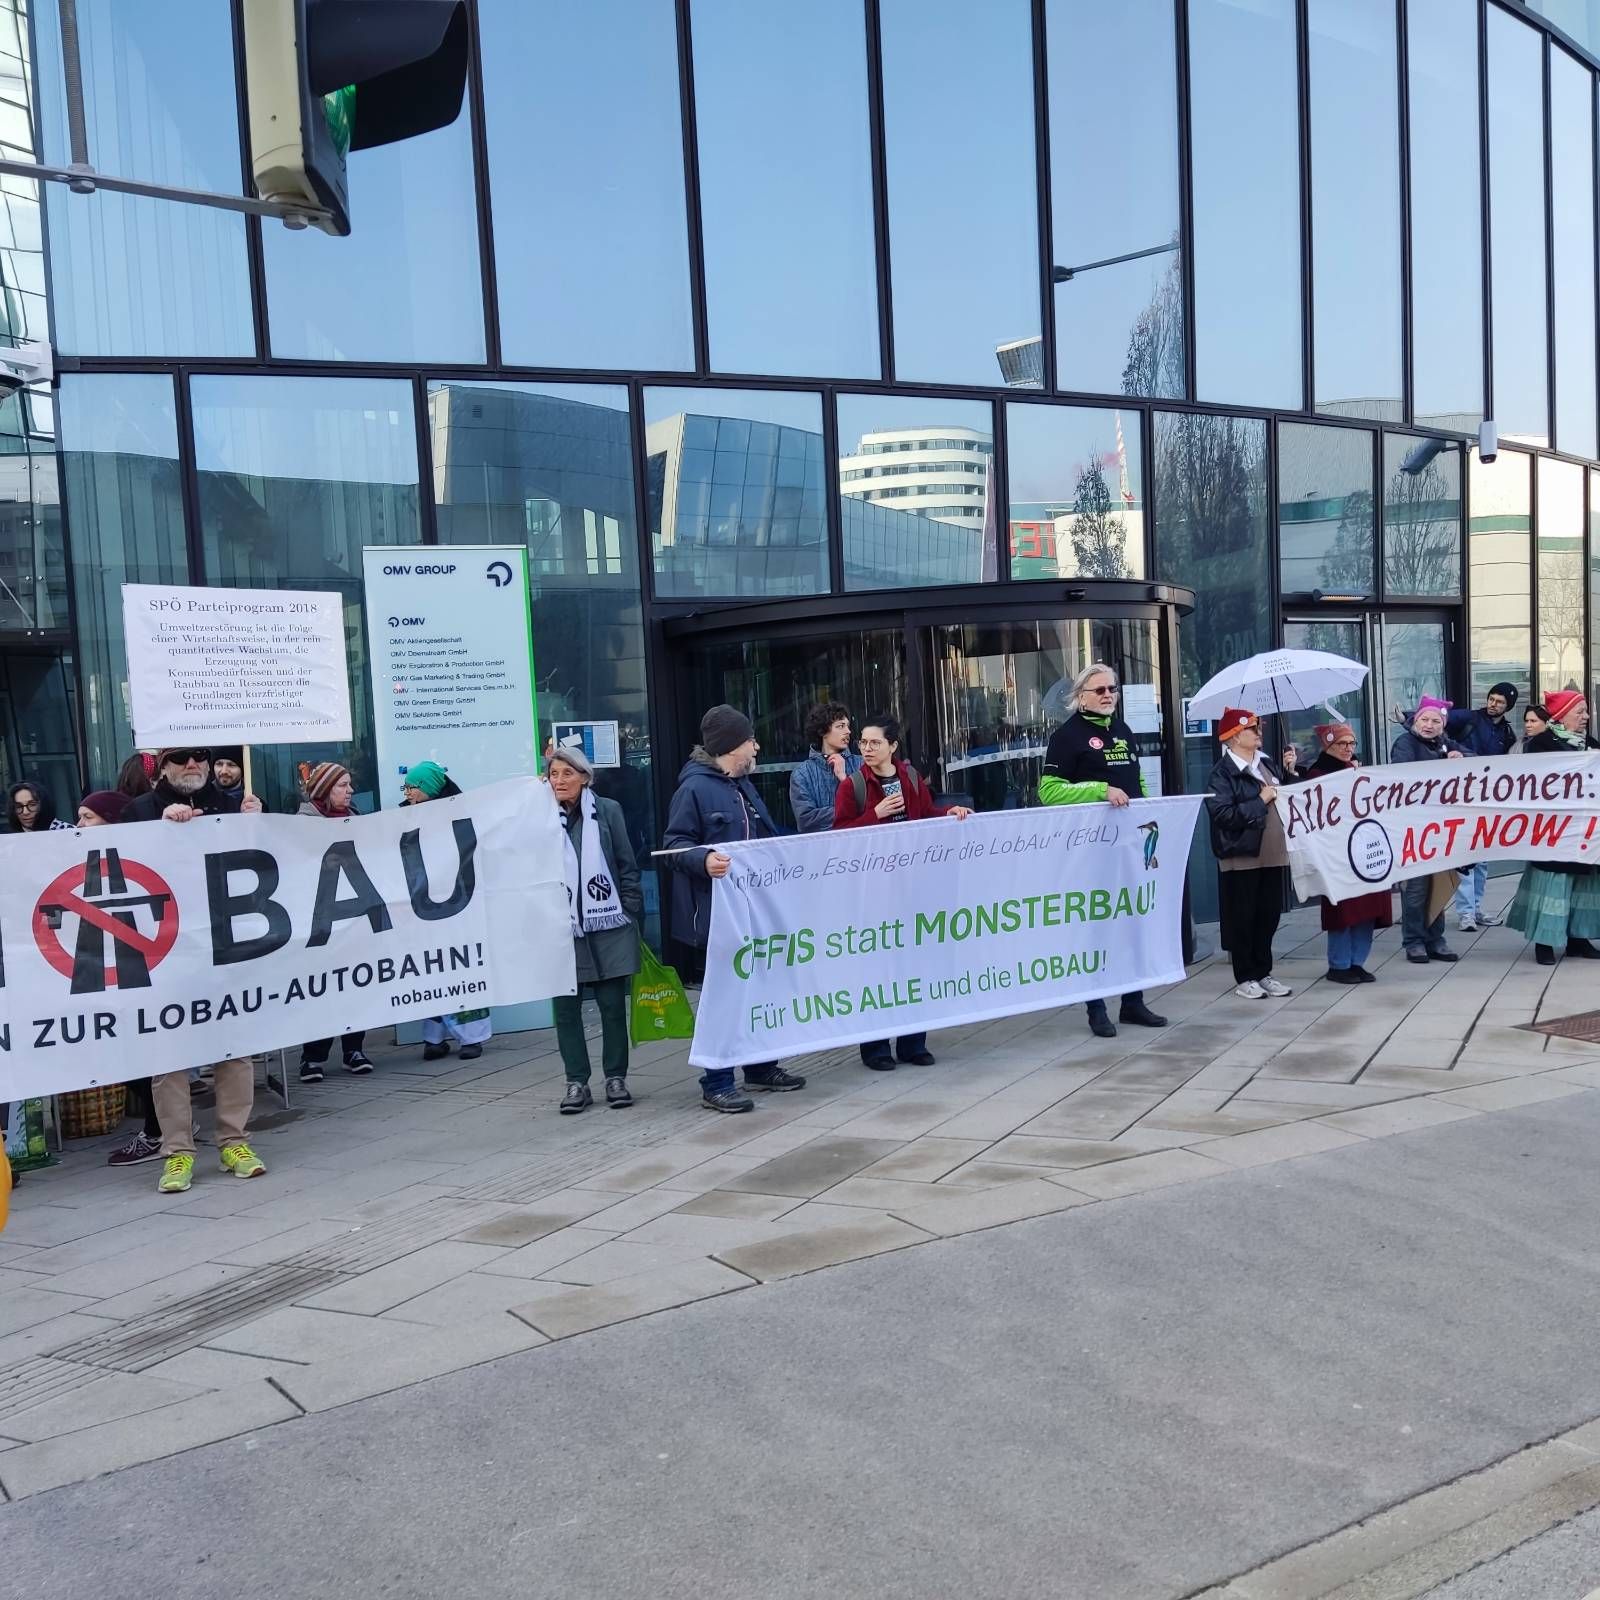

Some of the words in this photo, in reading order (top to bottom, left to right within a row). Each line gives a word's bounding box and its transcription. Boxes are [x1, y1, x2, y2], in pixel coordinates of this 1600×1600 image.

[383, 566, 411, 576] OMV
[415, 564, 456, 575] GROUP
[149, 597, 182, 612] SPÖ
[187, 600, 284, 614] Parteiprogram
[289, 602, 318, 613] 2018
[402, 617, 425, 626] OMV
[159, 622, 252, 634] Umweltzerstörung
[256, 624, 268, 632] ist
[270, 624, 286, 632] die
[289, 623, 314, 634] Folge
[151, 635, 178, 644] einer
[272, 635, 282, 643] in
[284, 634, 300, 643] der
[303, 635, 321, 644] rein
[168, 646, 235, 656] quantitatives
[294, 646, 309, 654] die
[204, 657, 258, 668] Erzeugung
[276, 668, 294, 676] und
[297, 668, 312, 676] der
[174, 679, 220, 688] Raubbau
[224, 680, 236, 688] an
[239, 678, 293, 688] Ressourcen
[296, 678, 310, 687] die
[416, 686, 454, 694] International
[182, 690, 242, 702] Grundlagen
[246, 690, 304, 700] kurzfristiger
[184, 701, 279, 712] Profitmaximierung
[282, 700, 304, 709] sind.
[432, 698, 454, 706] Energy
[488, 720, 499, 728] der
[1105, 752, 1128, 760] KEINE
[1287, 782, 1342, 839] Alle
[1350, 765, 1596, 819] Generationen:
[923, 844, 958, 867] für
[958, 837, 985, 861] die
[1066, 824, 1120, 851] (EfdL)
[1401, 818, 1466, 867] ACT
[1470, 813, 1572, 851] NOW
[1579, 815, 1598, 850] !
[1366, 850, 1384, 860] GEGEN
[1366, 859, 1386, 870] RECHTS
[204, 817, 478, 966] BAU
[587, 906, 618, 914] #NOBAU
[825, 918, 906, 958] statt
[914, 880, 1156, 946] MONSTERBAU!
[32, 1012, 117, 1048] ZUR
[137, 942, 485, 1035] LOBAU-AUTOBAHN!
[390, 979, 487, 1008] nobau.wien
[751, 1003, 788, 1033] Für
[792, 990, 854, 1023] UNS
[859, 978, 924, 1014] ALLE
[929, 970, 972, 1000] und
[978, 966, 1012, 992] die
[1017, 950, 1108, 985] LOBAU!
